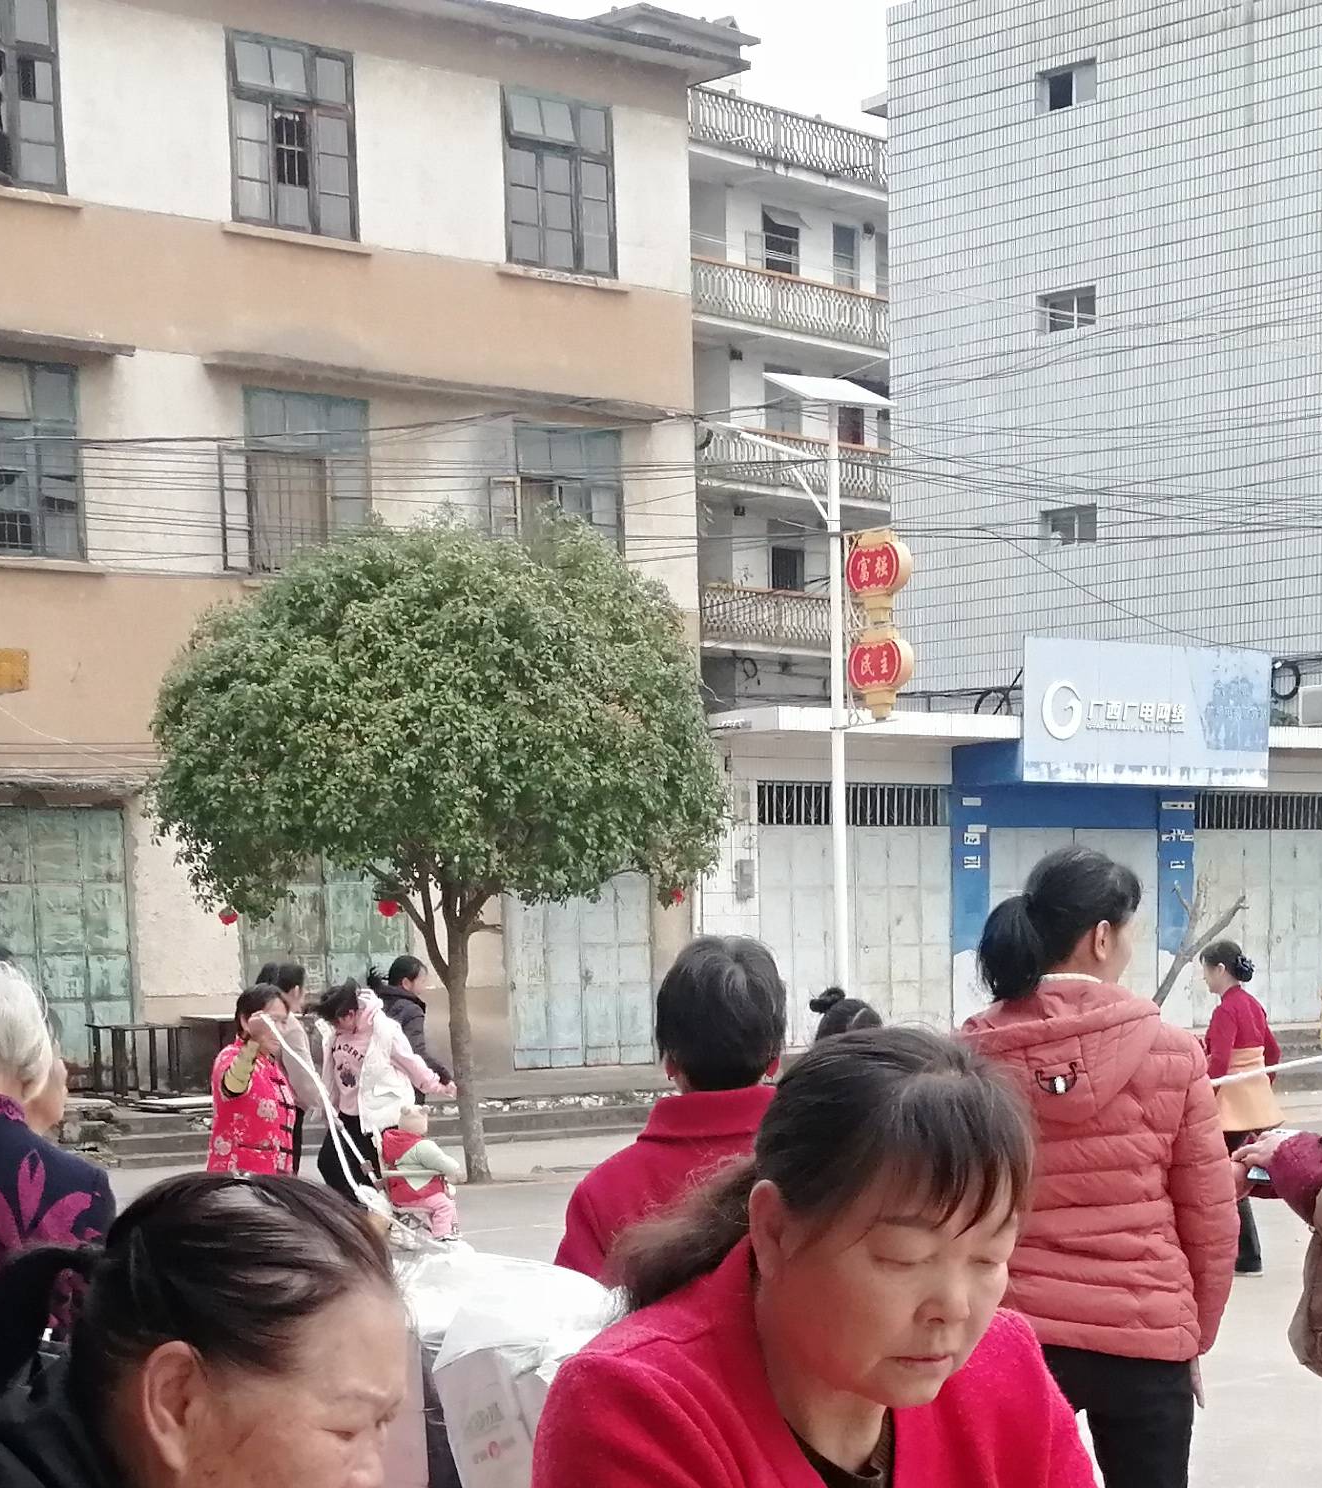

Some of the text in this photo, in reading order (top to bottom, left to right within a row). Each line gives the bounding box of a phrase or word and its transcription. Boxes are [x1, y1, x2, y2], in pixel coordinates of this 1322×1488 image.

[857, 556, 889, 582] 富强
[860, 650, 889, 677] 民主
[1086, 699, 1187, 725] 广西广电网络
